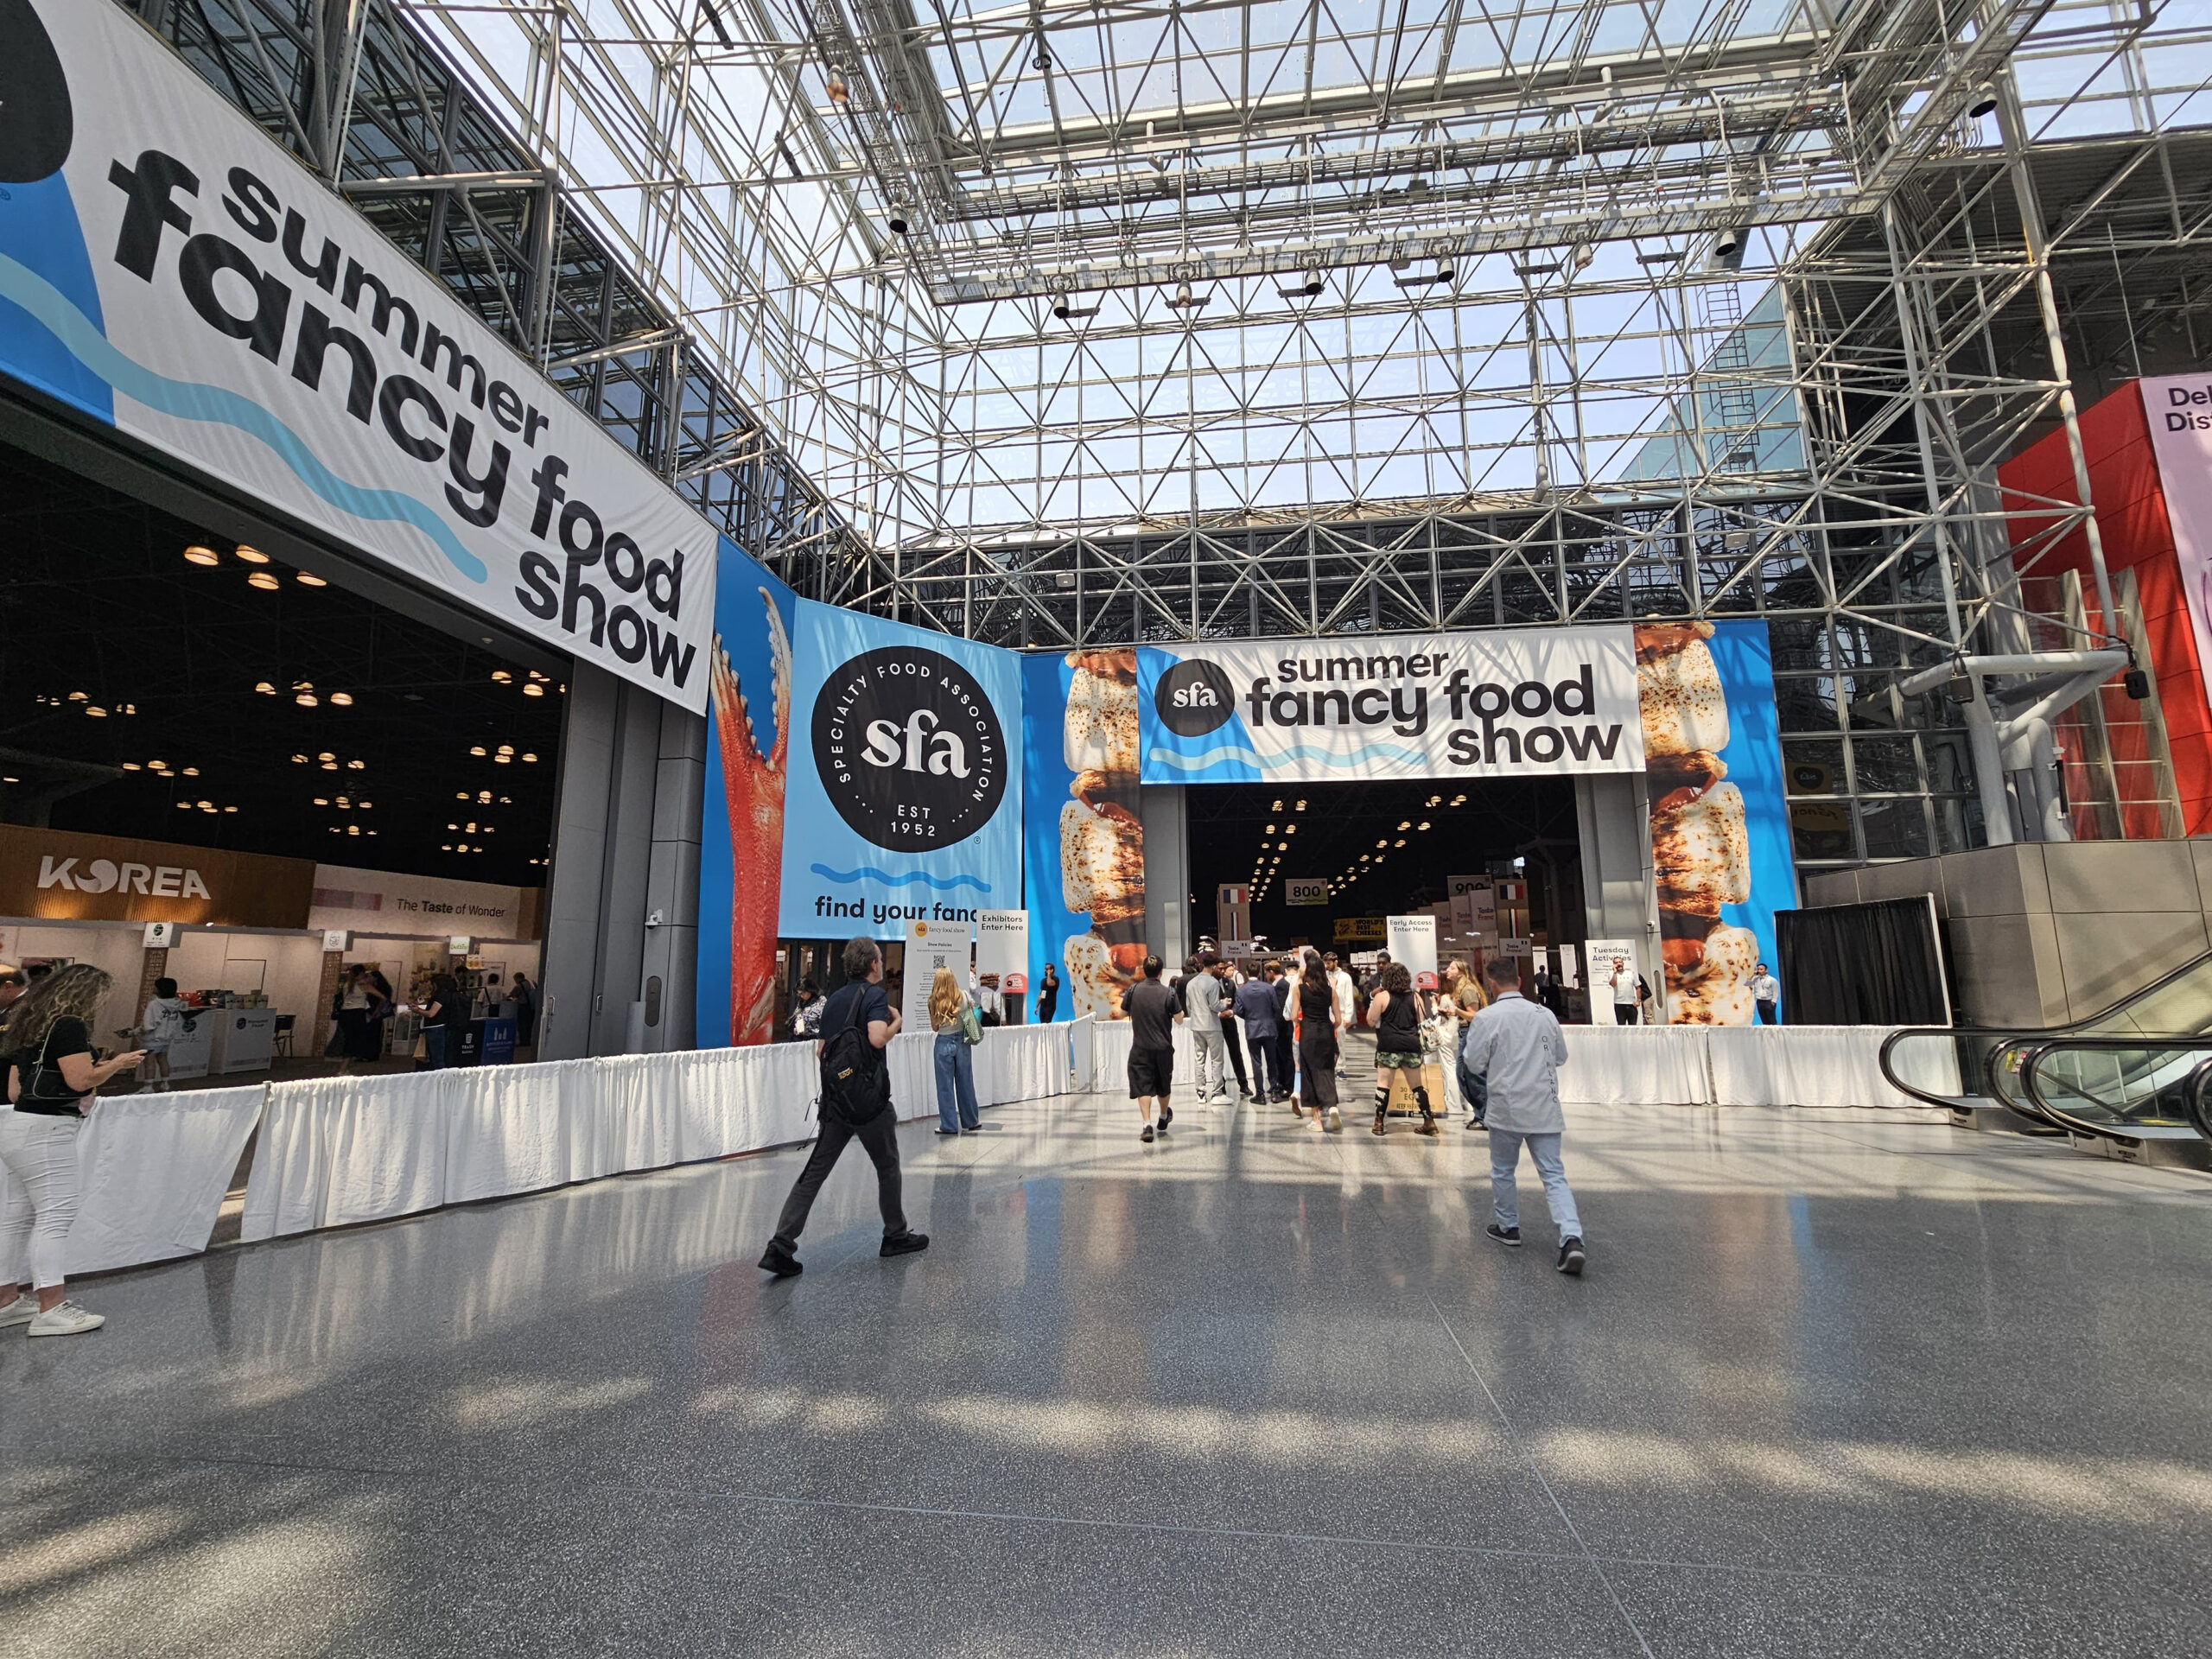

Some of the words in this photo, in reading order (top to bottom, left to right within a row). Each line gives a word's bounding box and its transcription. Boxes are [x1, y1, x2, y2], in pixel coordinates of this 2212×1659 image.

[221, 166, 549, 448] summer
[108, 149, 512, 528] fancy
[531, 454, 684, 621] food
[2164, 411, 2212, 432] Dis
[515, 550, 696, 689] show
[1277, 652, 1449, 683] summer
[1173, 681, 1218, 709] sfa
[1246, 677, 1429, 737] fancy
[1443, 664, 1596, 719] food
[830, 675, 868, 783] SPECIALTY
[876, 663, 931, 678] FOOD
[940, 677, 993, 801] ASSOCIATION
[861, 709, 971, 779] sfa
[1447, 717, 1623, 766] show
[898, 804, 931, 818] EST
[891, 822, 935, 836] 1952
[36, 855, 212, 899] KOREA
[1293, 886, 1321, 898] 800
[397, 898, 418, 912] The
[422, 900, 454, 914] Taste
[455, 903, 467, 915] of
[468, 904, 505, 918] Wonder
[815, 895, 865, 918] find
[873, 904, 926, 924] your
[982, 914, 1023, 923] Exhibitors
[1592, 946, 1629, 955] Tuesday
